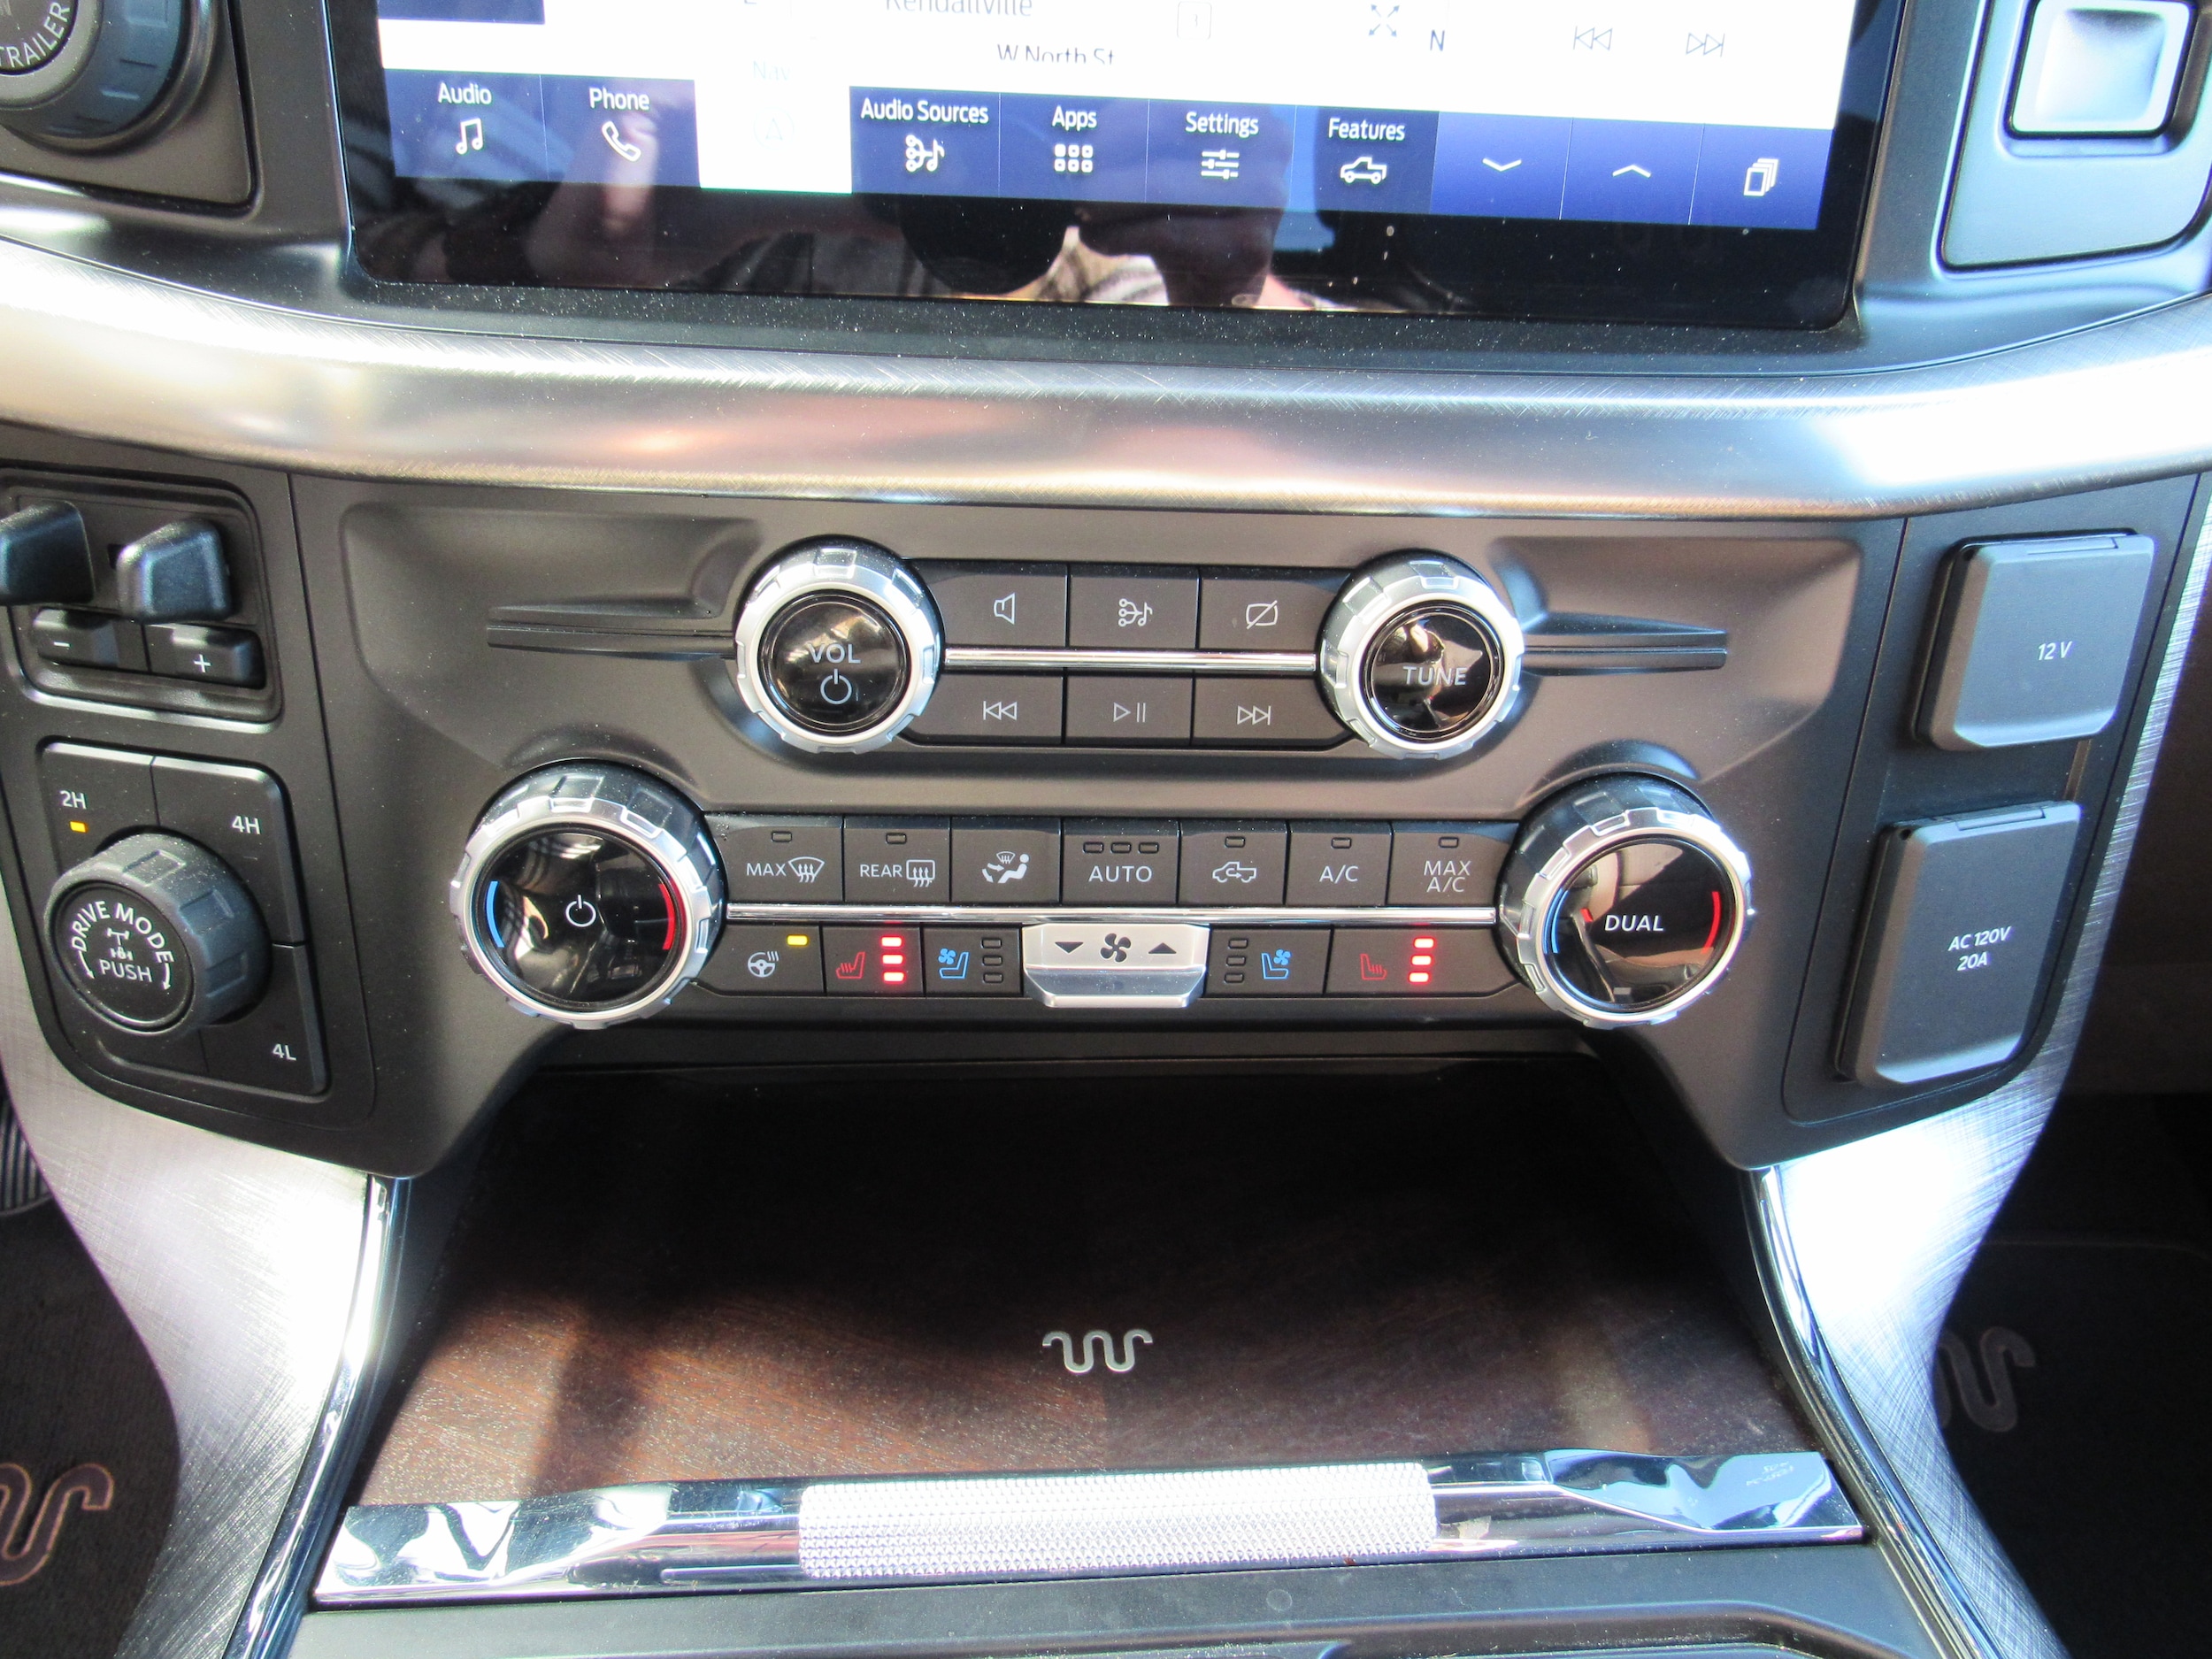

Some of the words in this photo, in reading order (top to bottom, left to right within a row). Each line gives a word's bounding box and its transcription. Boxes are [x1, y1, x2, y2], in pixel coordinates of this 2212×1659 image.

[1430, 29, 1445, 51] N
[997, 43, 1018, 61] W
[437, 82, 492, 105] Audio
[589, 88, 649, 111] Phone
[860, 98, 914, 121] Audio
[917, 101, 989, 125] Sources
[1052, 106, 1097, 130] Apps
[1186, 111, 1259, 137] Settings
[1328, 118, 1405, 142] Features
[807, 643, 861, 665] VOL
[2037, 643, 2057, 660] 12
[2060, 641, 2072, 657] V
[1402, 666, 1467, 687] TUNE
[60, 790, 87, 810] 2H
[232, 816, 261, 834] 4H
[747, 863, 786, 877] MAX
[860, 864, 902, 878] REAR
[1089, 866, 1153, 883] AUTO
[1319, 865, 1359, 883] A/C
[1424, 860, 1471, 876] MAX
[1427, 877, 1465, 894] A/C
[71, 901, 111, 952] DRIVE
[115, 902, 175, 964] MODE
[1604, 914, 1664, 932] DUAL
[1947, 934, 1971, 951] AC
[1974, 926, 2013, 946] 120V
[98, 958, 152, 983] PUSH
[1956, 951, 1989, 972] 20A
[273, 1043, 296, 1061] 4L
